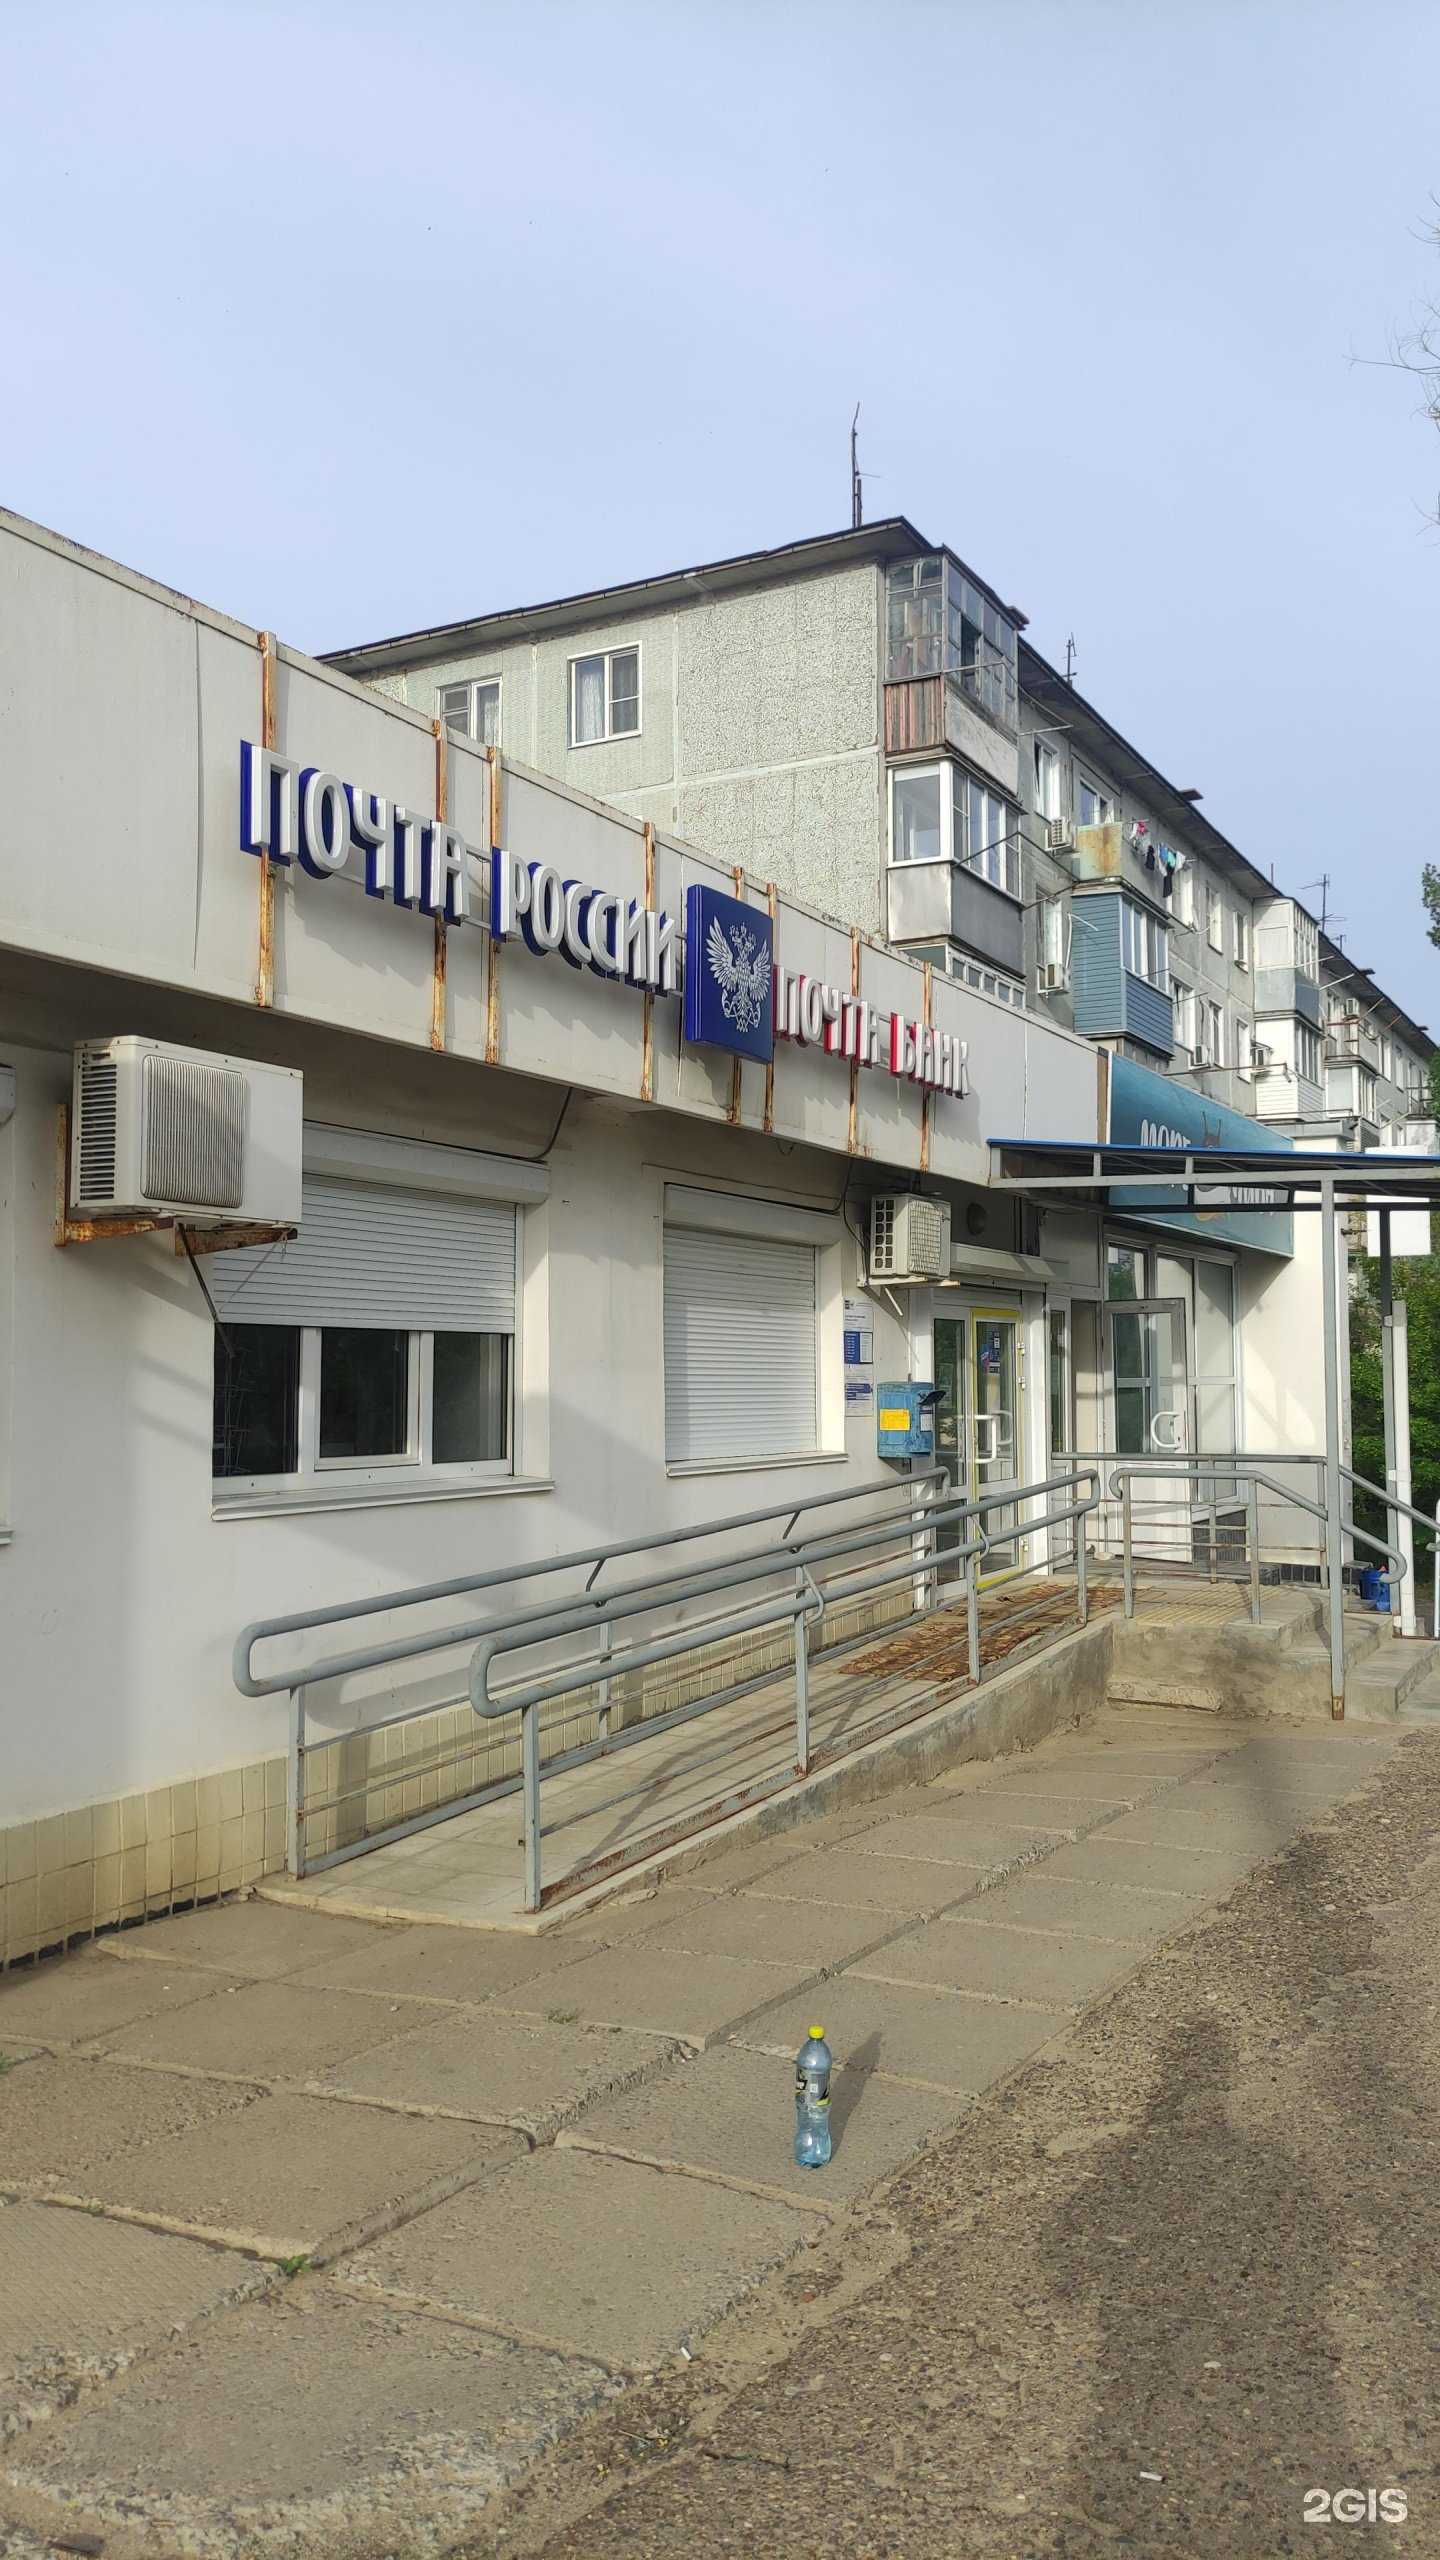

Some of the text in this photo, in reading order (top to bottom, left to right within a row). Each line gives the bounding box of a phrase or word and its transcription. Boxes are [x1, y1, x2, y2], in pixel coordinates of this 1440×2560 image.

[240, 739, 677, 997] ПОЧТА РОССИИ
[773, 964, 970, 1099] ПОЧТА БАНК
